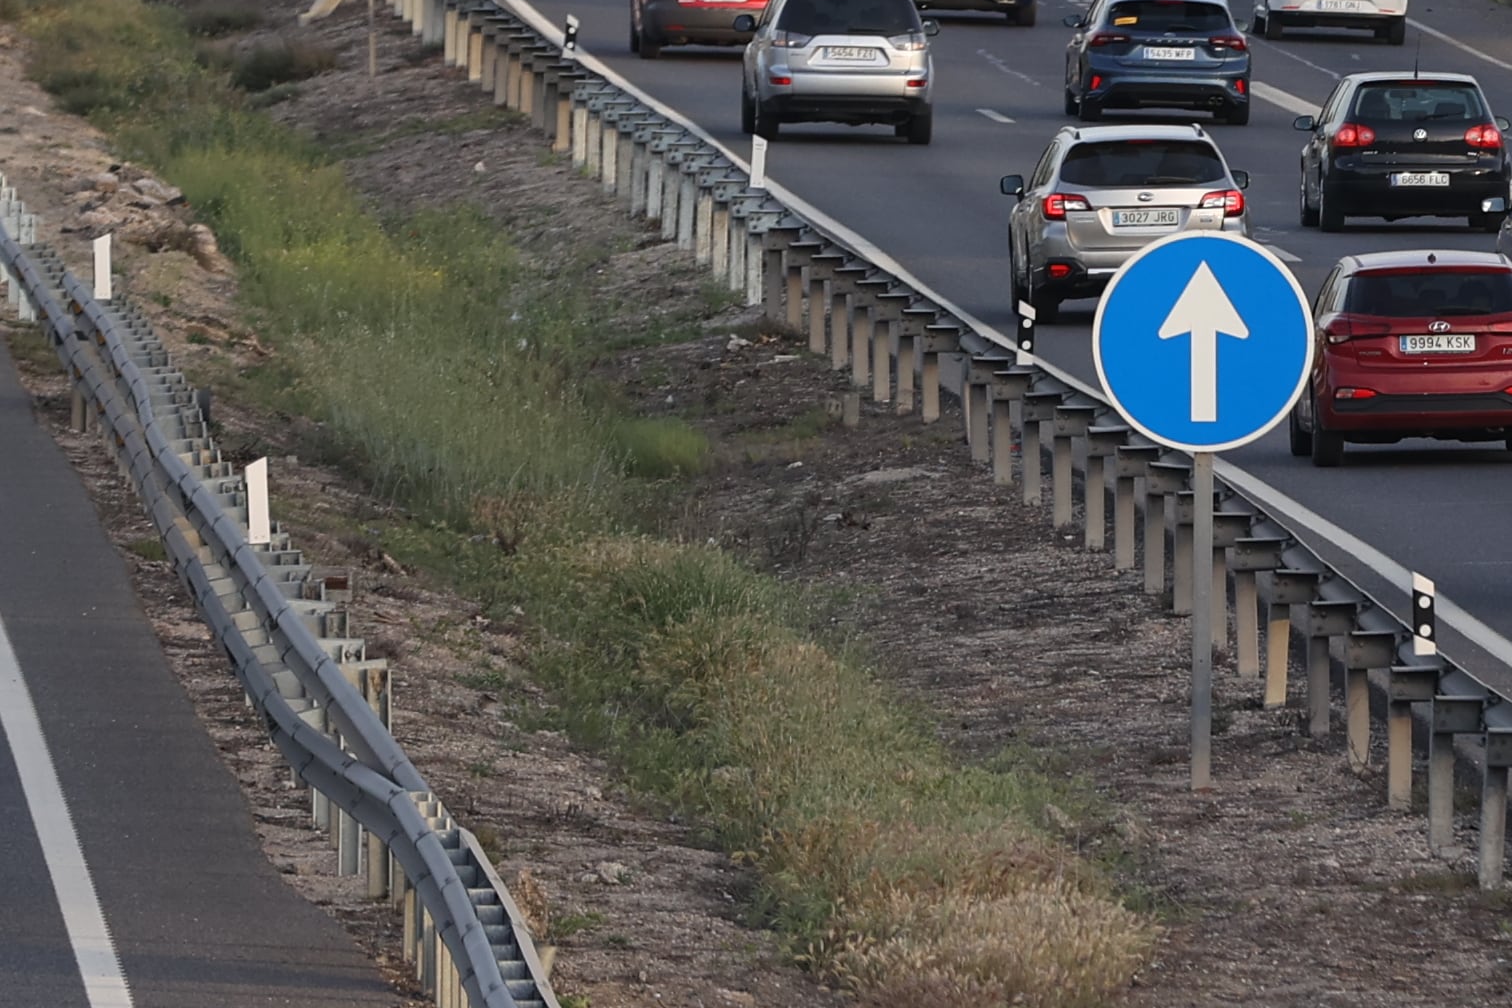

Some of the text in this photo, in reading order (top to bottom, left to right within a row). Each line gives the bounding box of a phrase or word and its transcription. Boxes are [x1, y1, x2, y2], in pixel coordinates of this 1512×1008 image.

[1429, 175, 1448, 184] FLC
[1122, 212, 1175, 223] 3027 JRG
[1409, 336, 1471, 349] 9994 KSK
